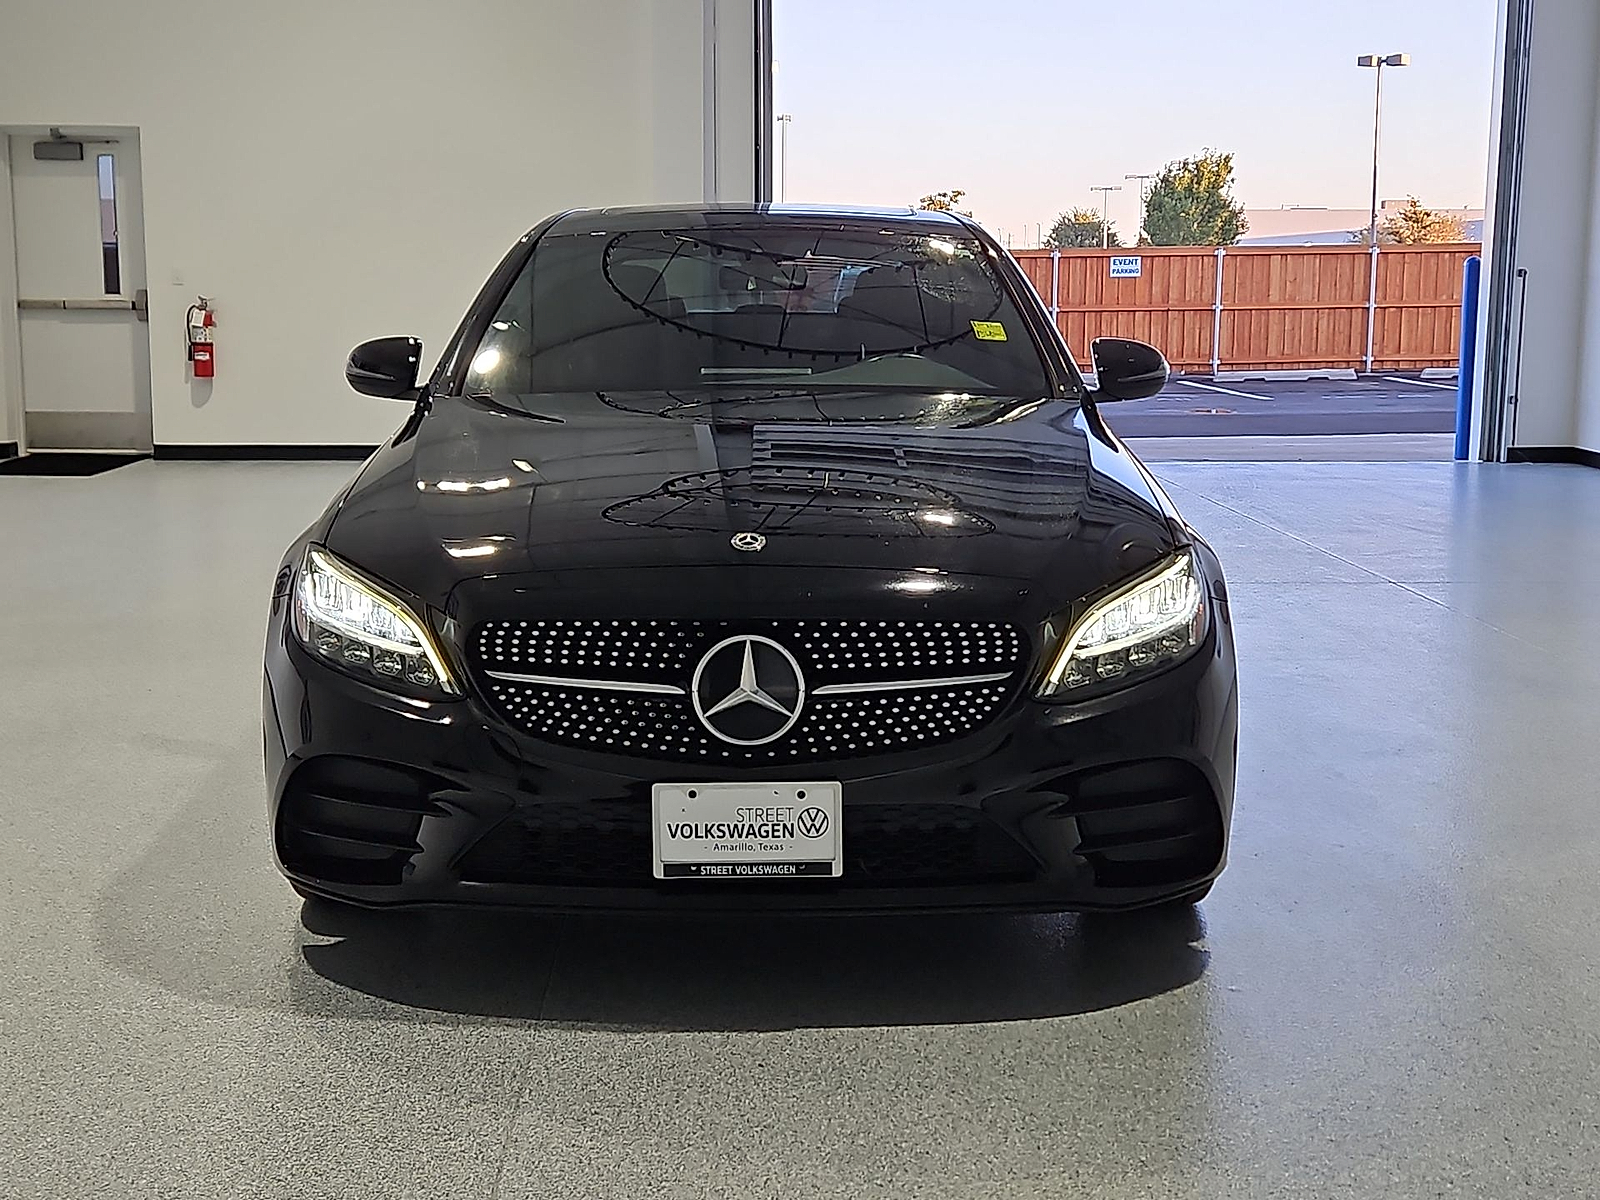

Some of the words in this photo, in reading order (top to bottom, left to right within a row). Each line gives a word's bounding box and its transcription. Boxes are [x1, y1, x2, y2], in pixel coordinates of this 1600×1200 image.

[1112, 258, 1139, 266] EVENT
[735, 807, 795, 823] STREET
[667, 823, 795, 839] VOLKSWAGEN
[713, 842, 756, 852] Amarillo,
[758, 842, 784, 851] Texas
[700, 865, 733, 875] STREET
[735, 864, 796, 874] VOLKSWAGEN
